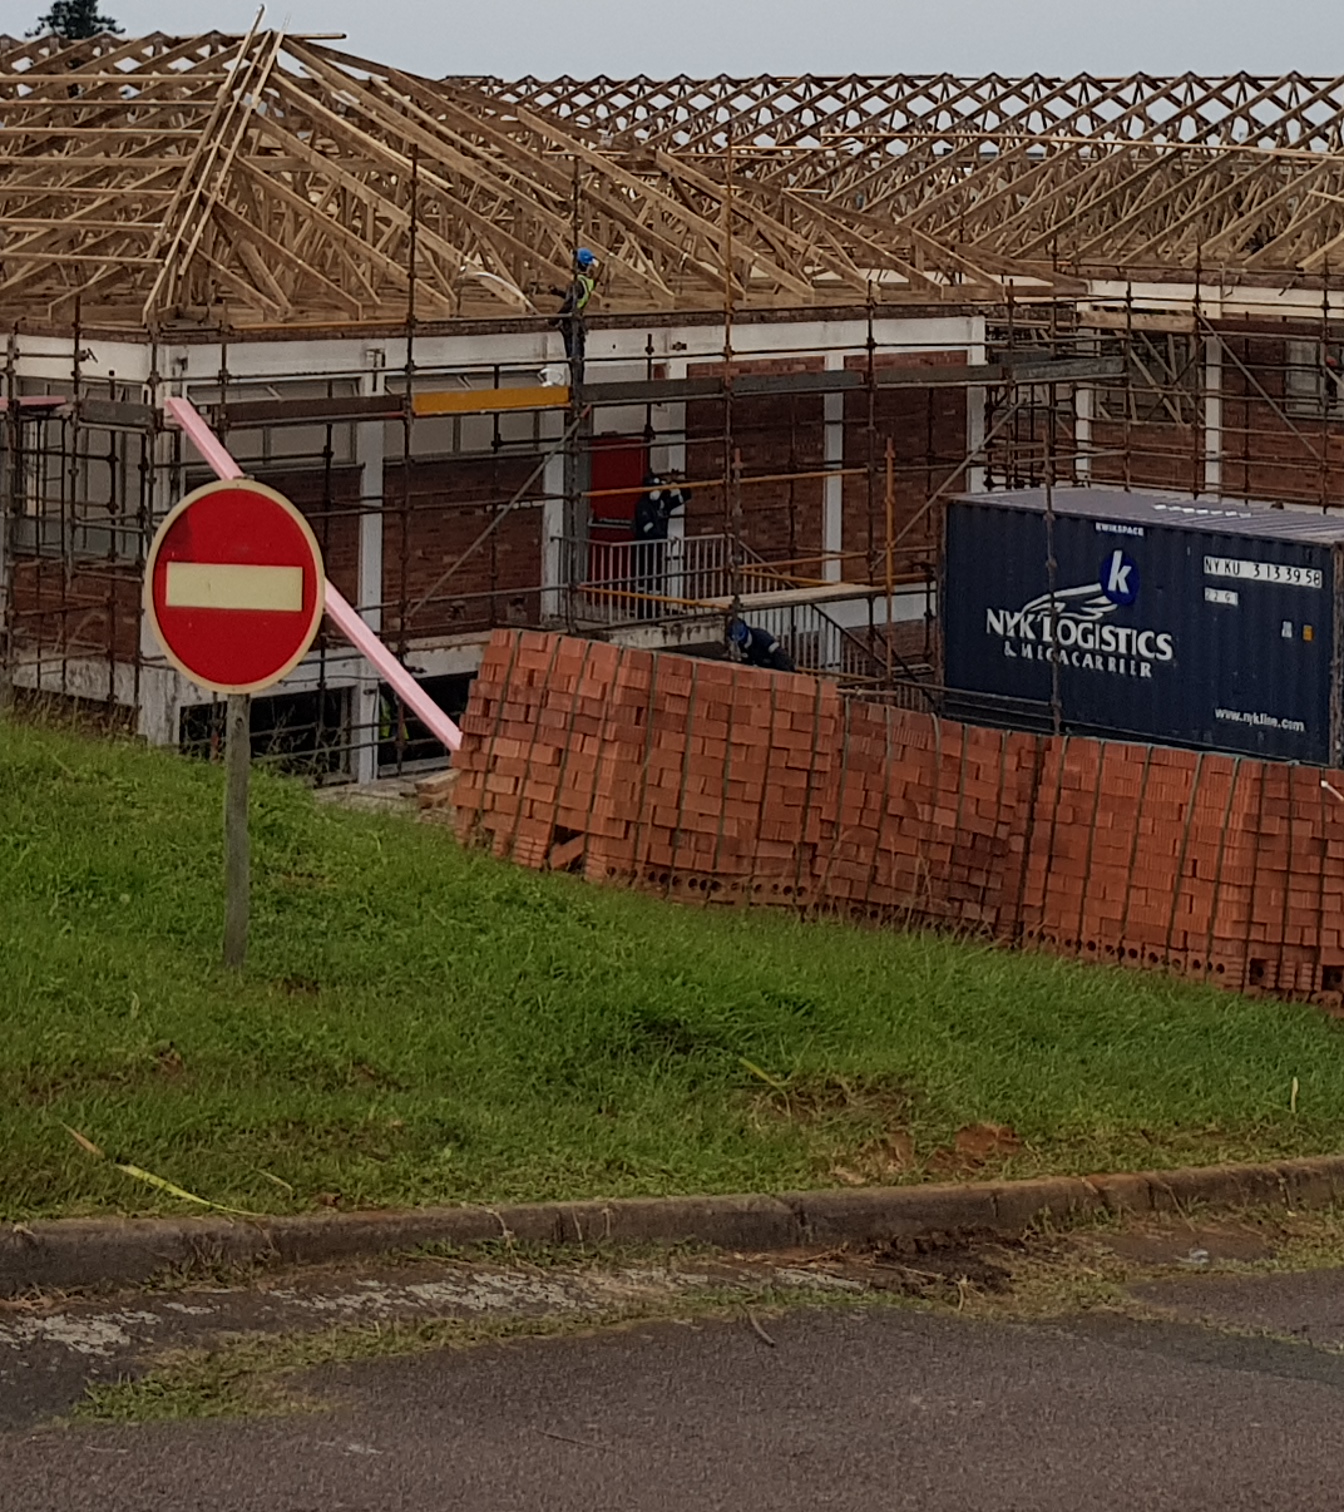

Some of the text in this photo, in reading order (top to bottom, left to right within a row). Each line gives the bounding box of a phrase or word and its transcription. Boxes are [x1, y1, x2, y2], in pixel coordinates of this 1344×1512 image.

[1205, 557, 1321, 587] NYKU 3133958
[986, 608, 1174, 661] NYK LOGISTICS
[1004, 641, 1152, 678] & MEGACARRIER
